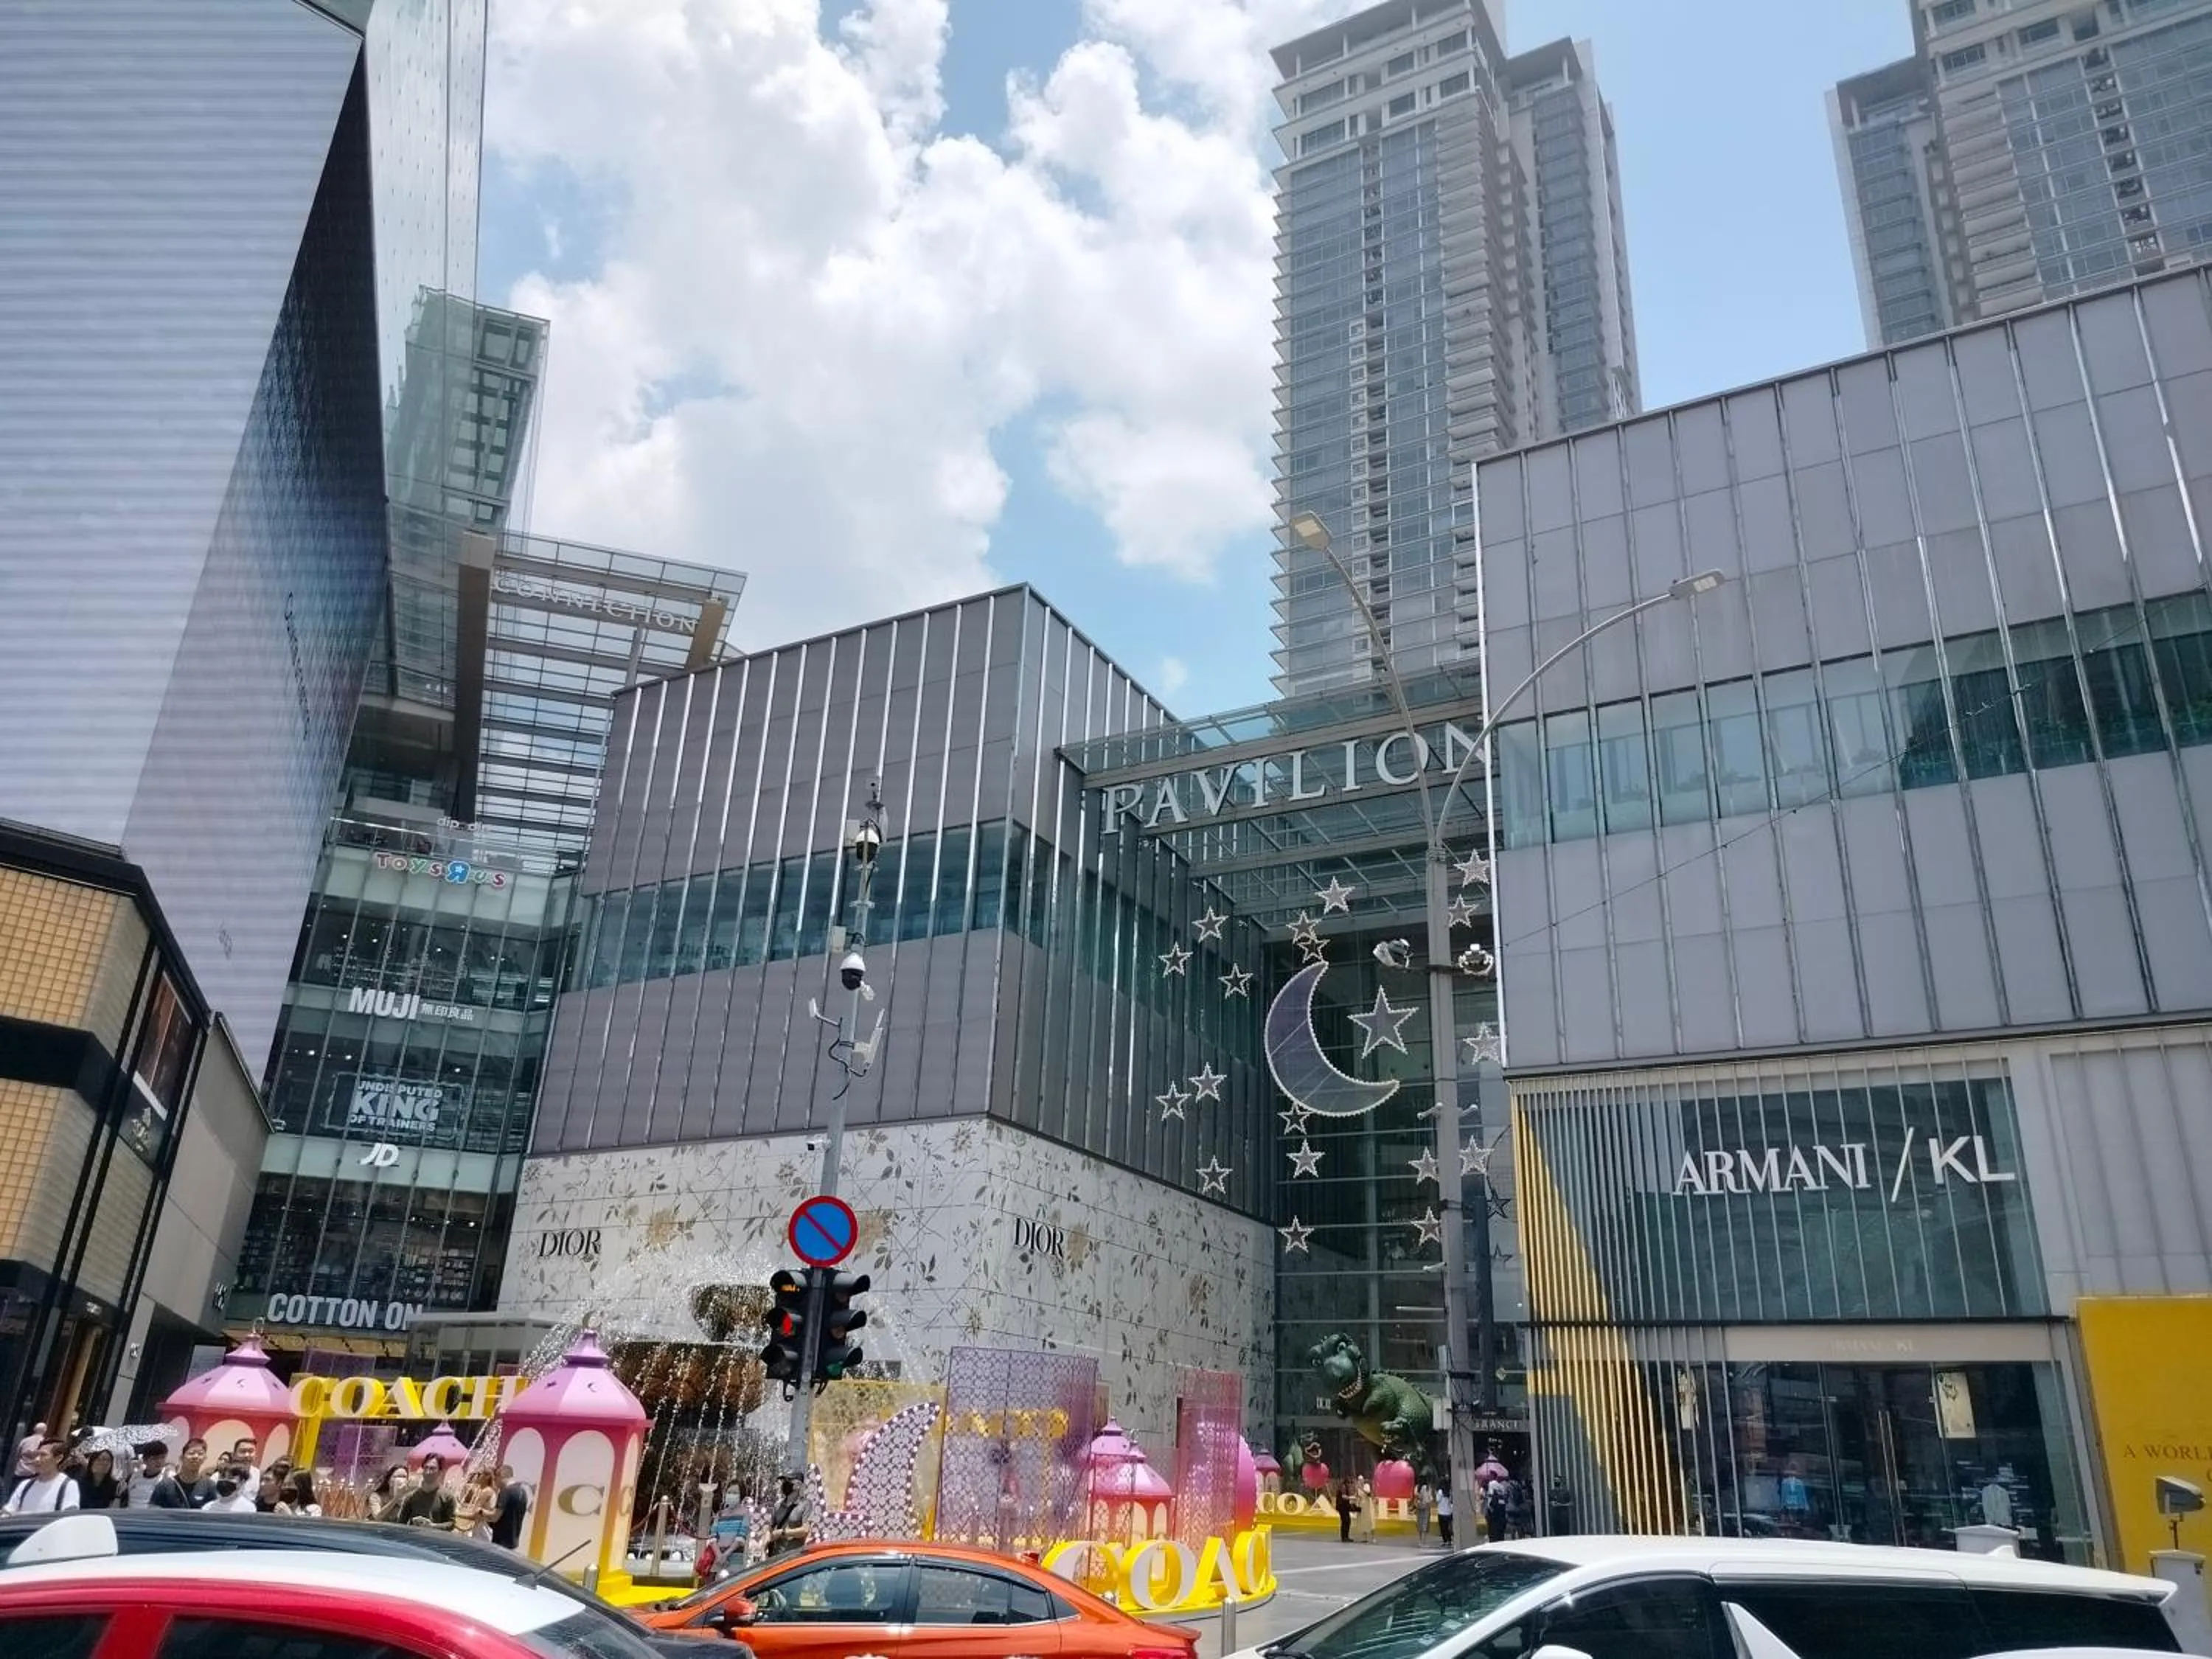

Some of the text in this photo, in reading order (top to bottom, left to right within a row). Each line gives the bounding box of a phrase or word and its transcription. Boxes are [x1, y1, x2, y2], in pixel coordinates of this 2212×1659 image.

[1103, 721, 1486, 835] PAVILION
[348, 987, 420, 1020] MUJI
[352, 1091, 440, 1121] KING
[349, 1114, 436, 1132] OF TRAINERS
[357, 1142, 399, 1167] JD
[1672, 1144, 1872, 1196] ARMANI
[1928, 1135, 2015, 1185] KL
[539, 1228, 601, 1257] DIOR
[1014, 1217, 1064, 1259] DIOR
[266, 1293, 422, 1331] COTTON ON
[288, 1375, 525, 1419] COACH
[2124, 1444, 2136, 1459] A
[1256, 1492, 1411, 1520] COAH
